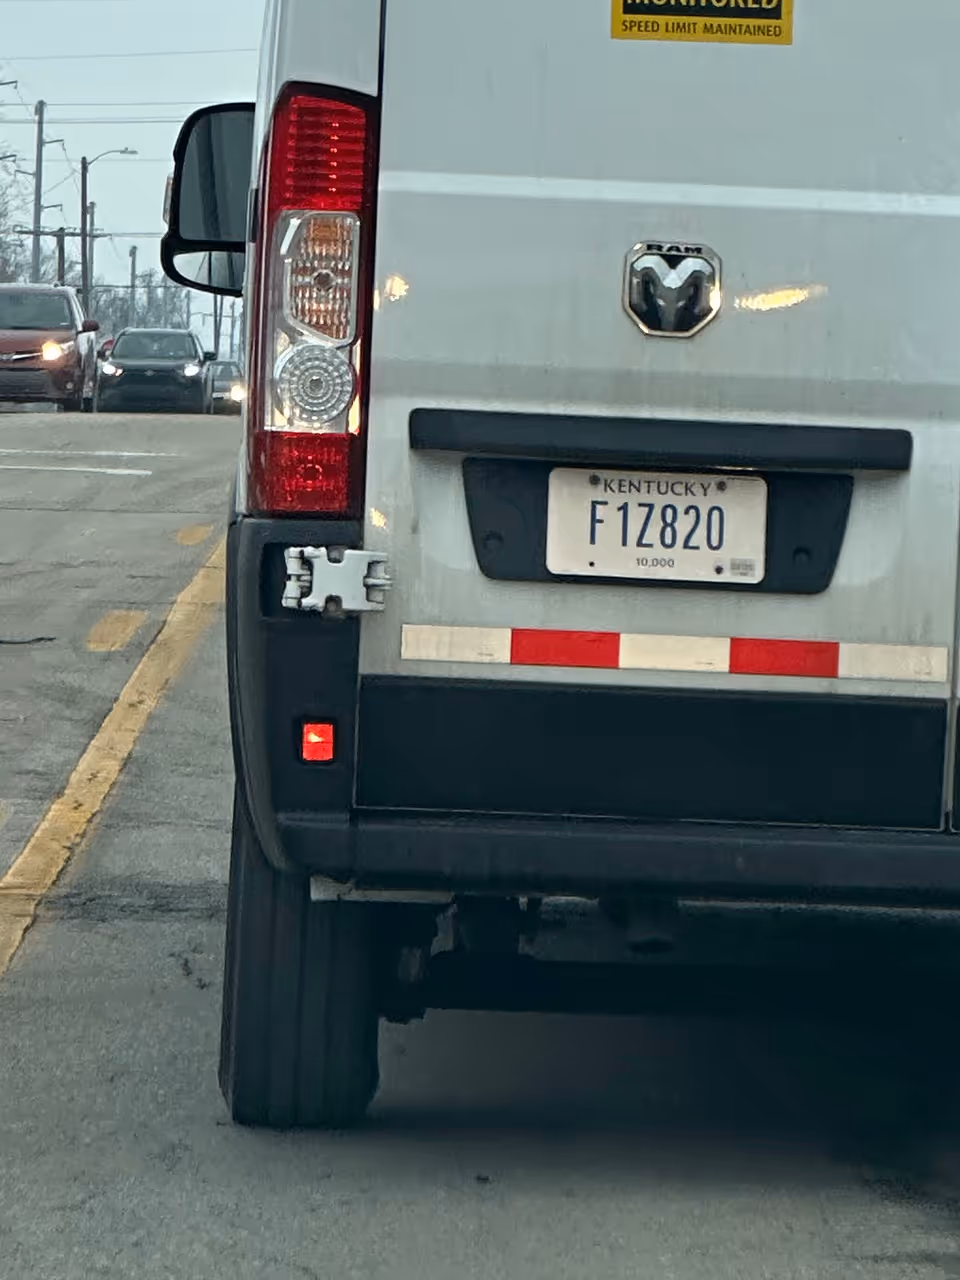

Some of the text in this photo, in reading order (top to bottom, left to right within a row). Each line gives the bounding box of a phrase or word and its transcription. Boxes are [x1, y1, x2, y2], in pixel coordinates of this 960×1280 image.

[621, 20, 782, 37] SPEED LIMIT MAINTAINED
[646, 244, 703, 255] RAM
[603, 478, 712, 497] KENTUCKY
[589, 500, 725, 551] F1Z820
[636, 557, 675, 569] 10,000
